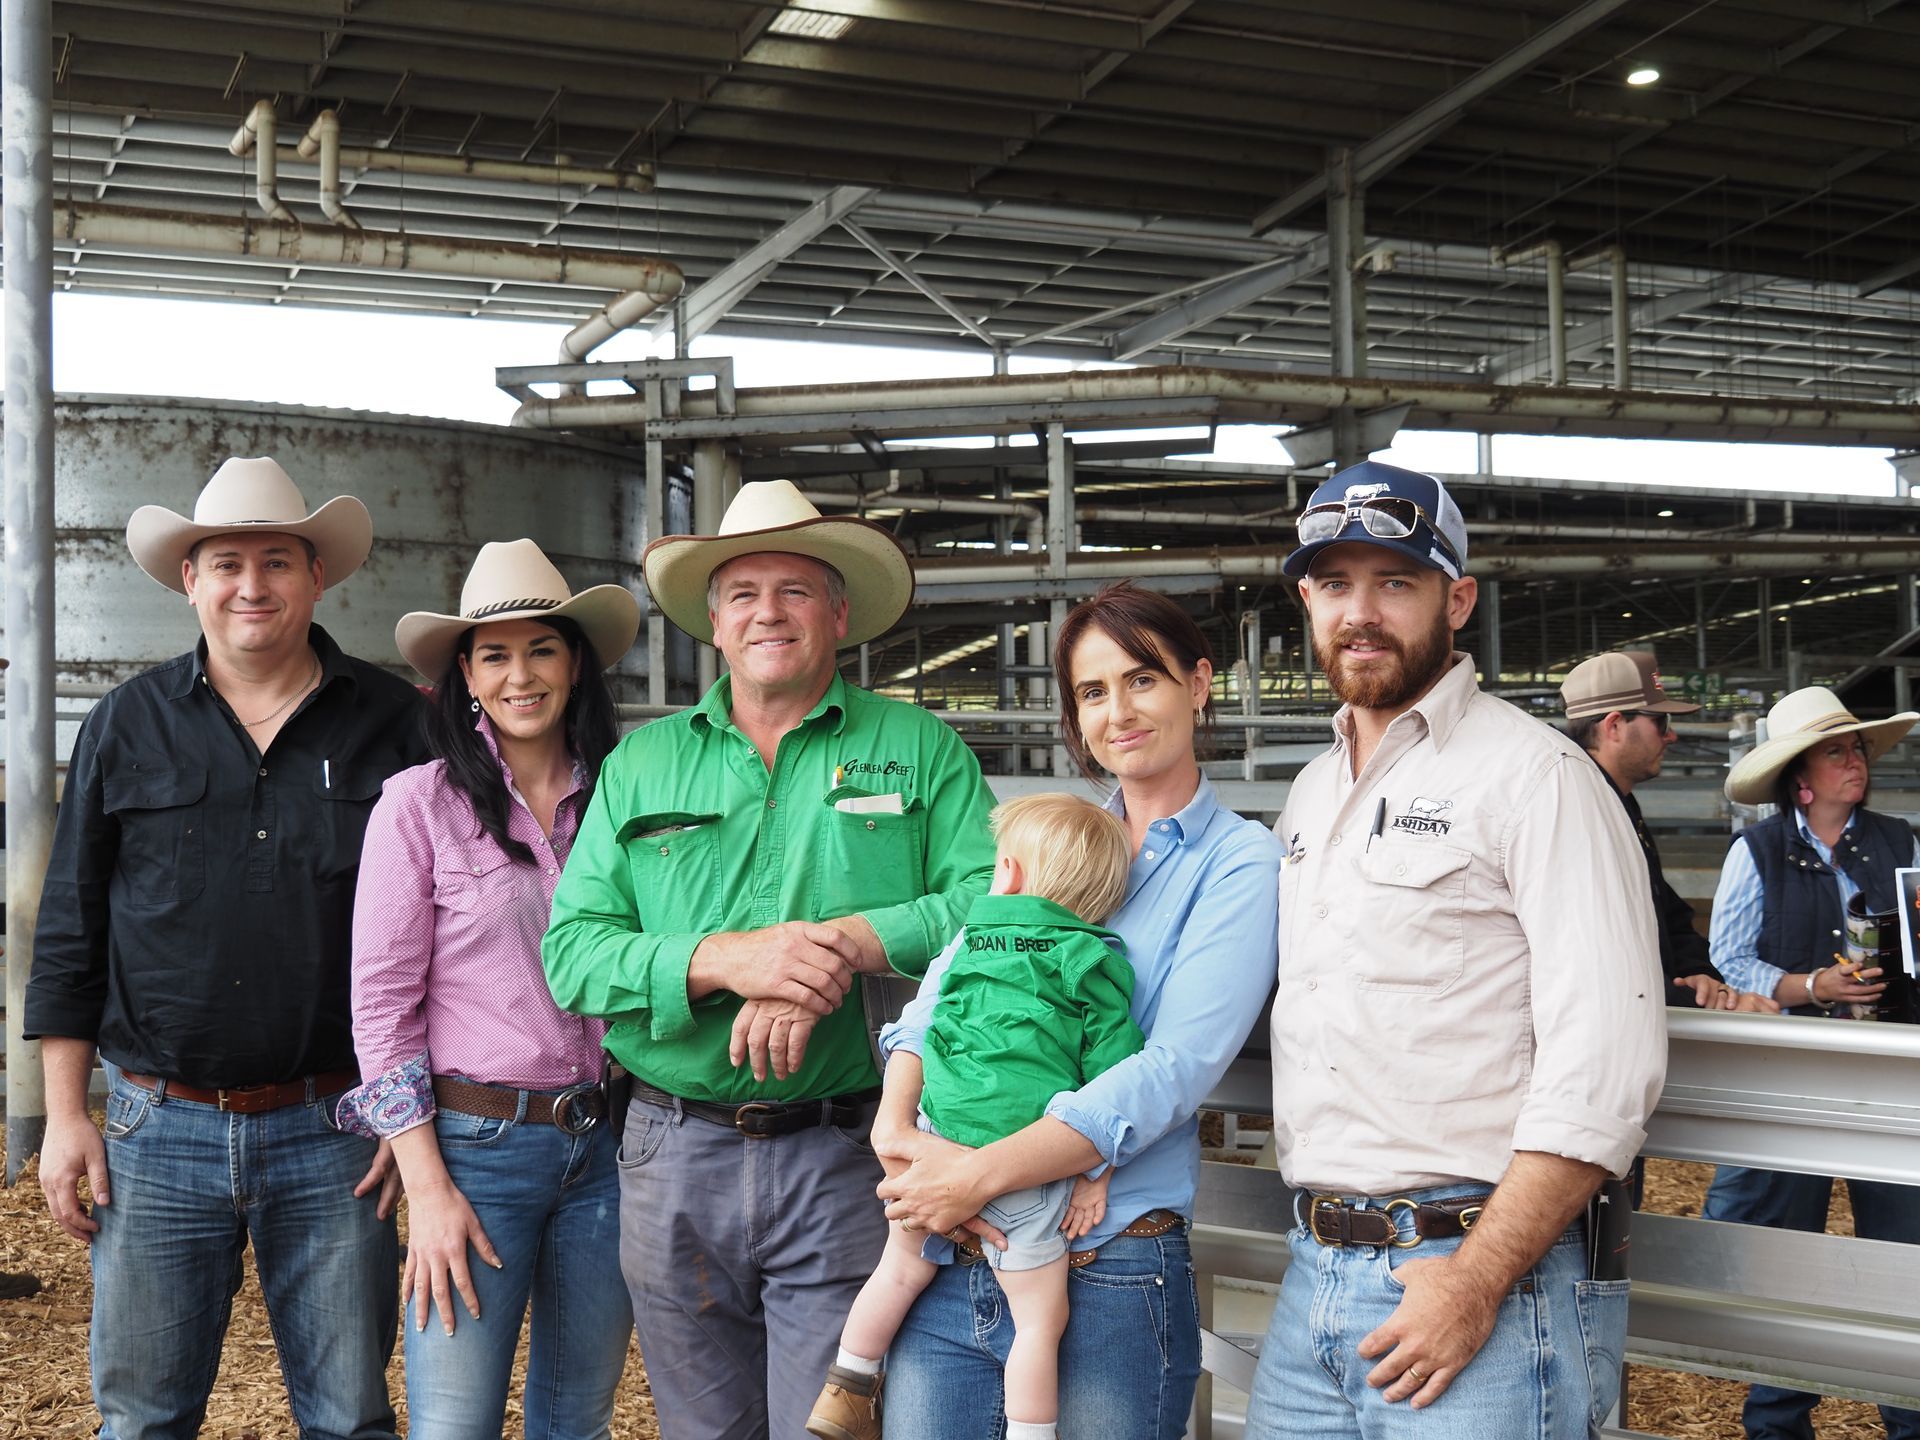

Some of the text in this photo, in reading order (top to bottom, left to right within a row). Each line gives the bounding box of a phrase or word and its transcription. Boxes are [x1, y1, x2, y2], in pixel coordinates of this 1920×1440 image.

[844, 759, 911, 777] GLENLEA BEEF
[1014, 936, 1058, 952] BRED
